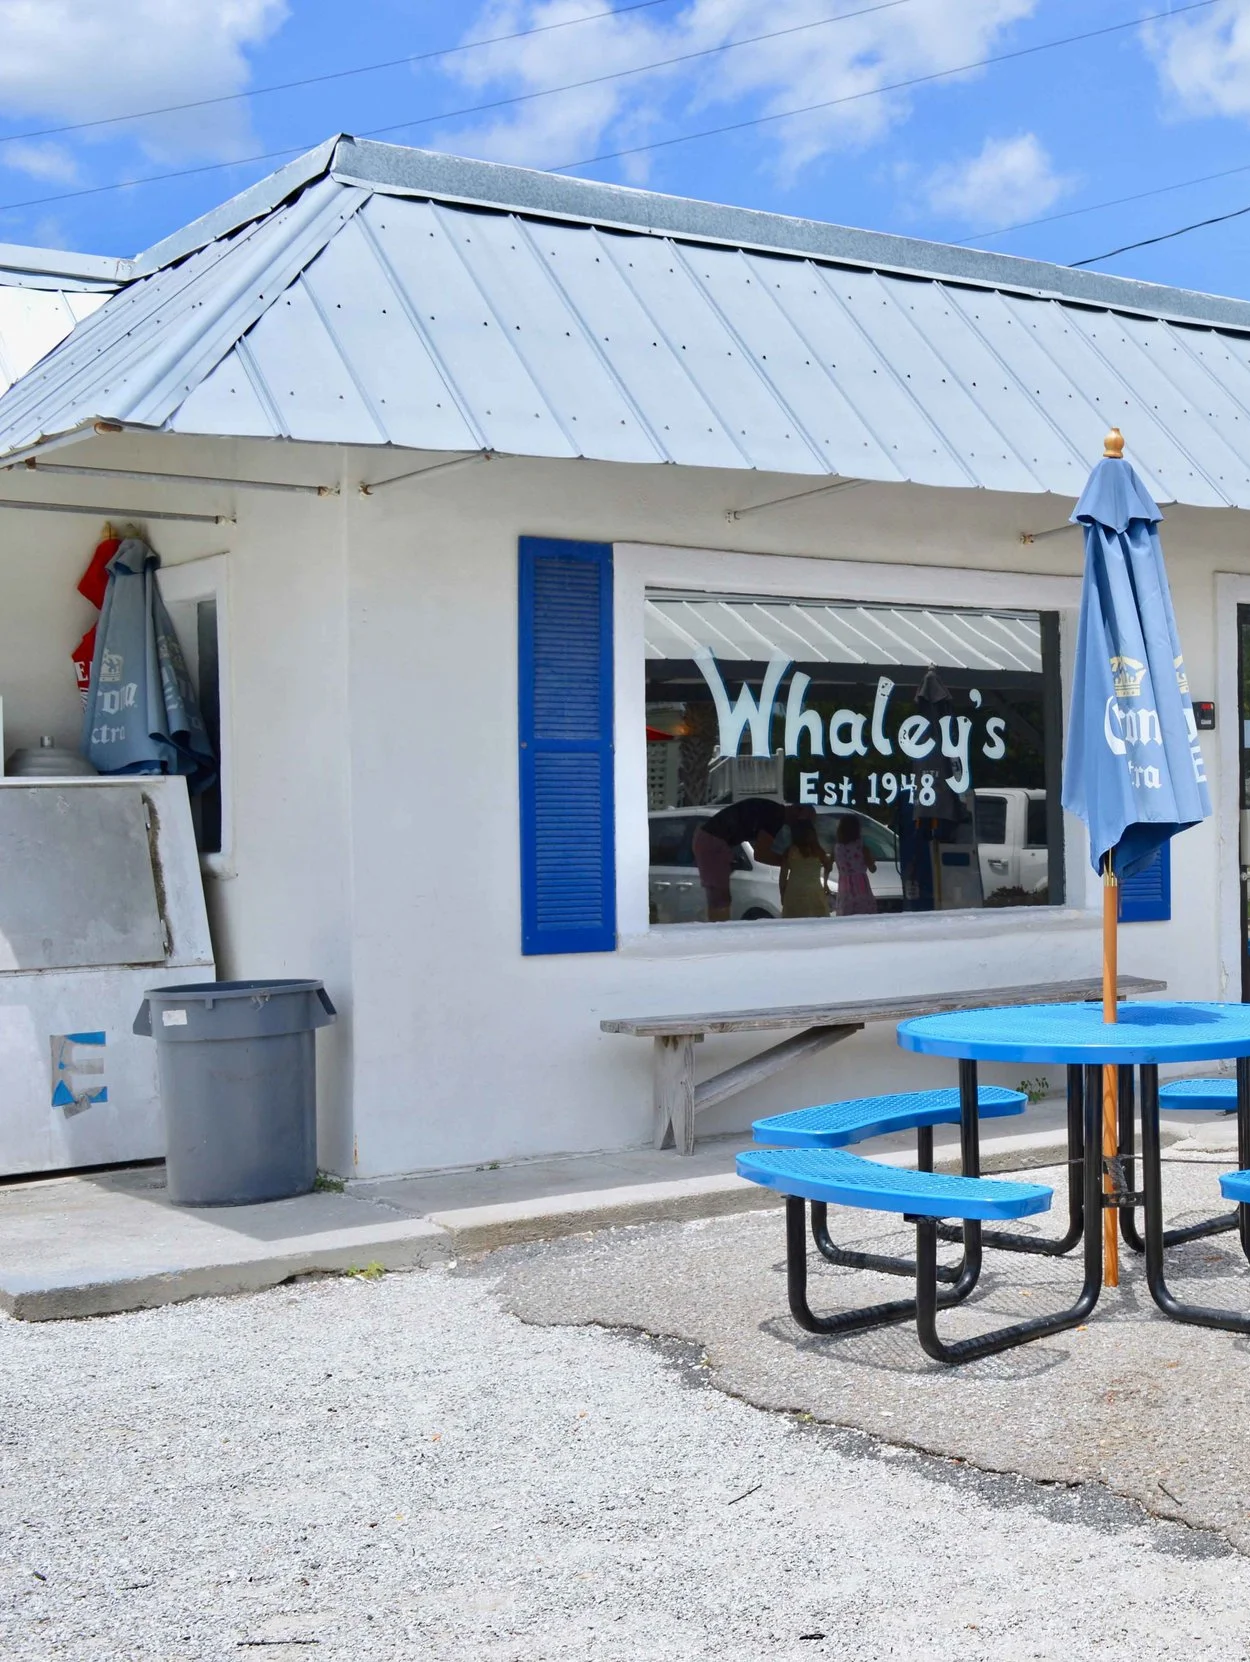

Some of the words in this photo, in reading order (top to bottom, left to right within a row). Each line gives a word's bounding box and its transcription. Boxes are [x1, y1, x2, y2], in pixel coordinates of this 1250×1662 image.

[693, 646, 1006, 793] Whaley's
[800, 770, 857, 804] Est.
[867, 772, 936, 807] 1948
